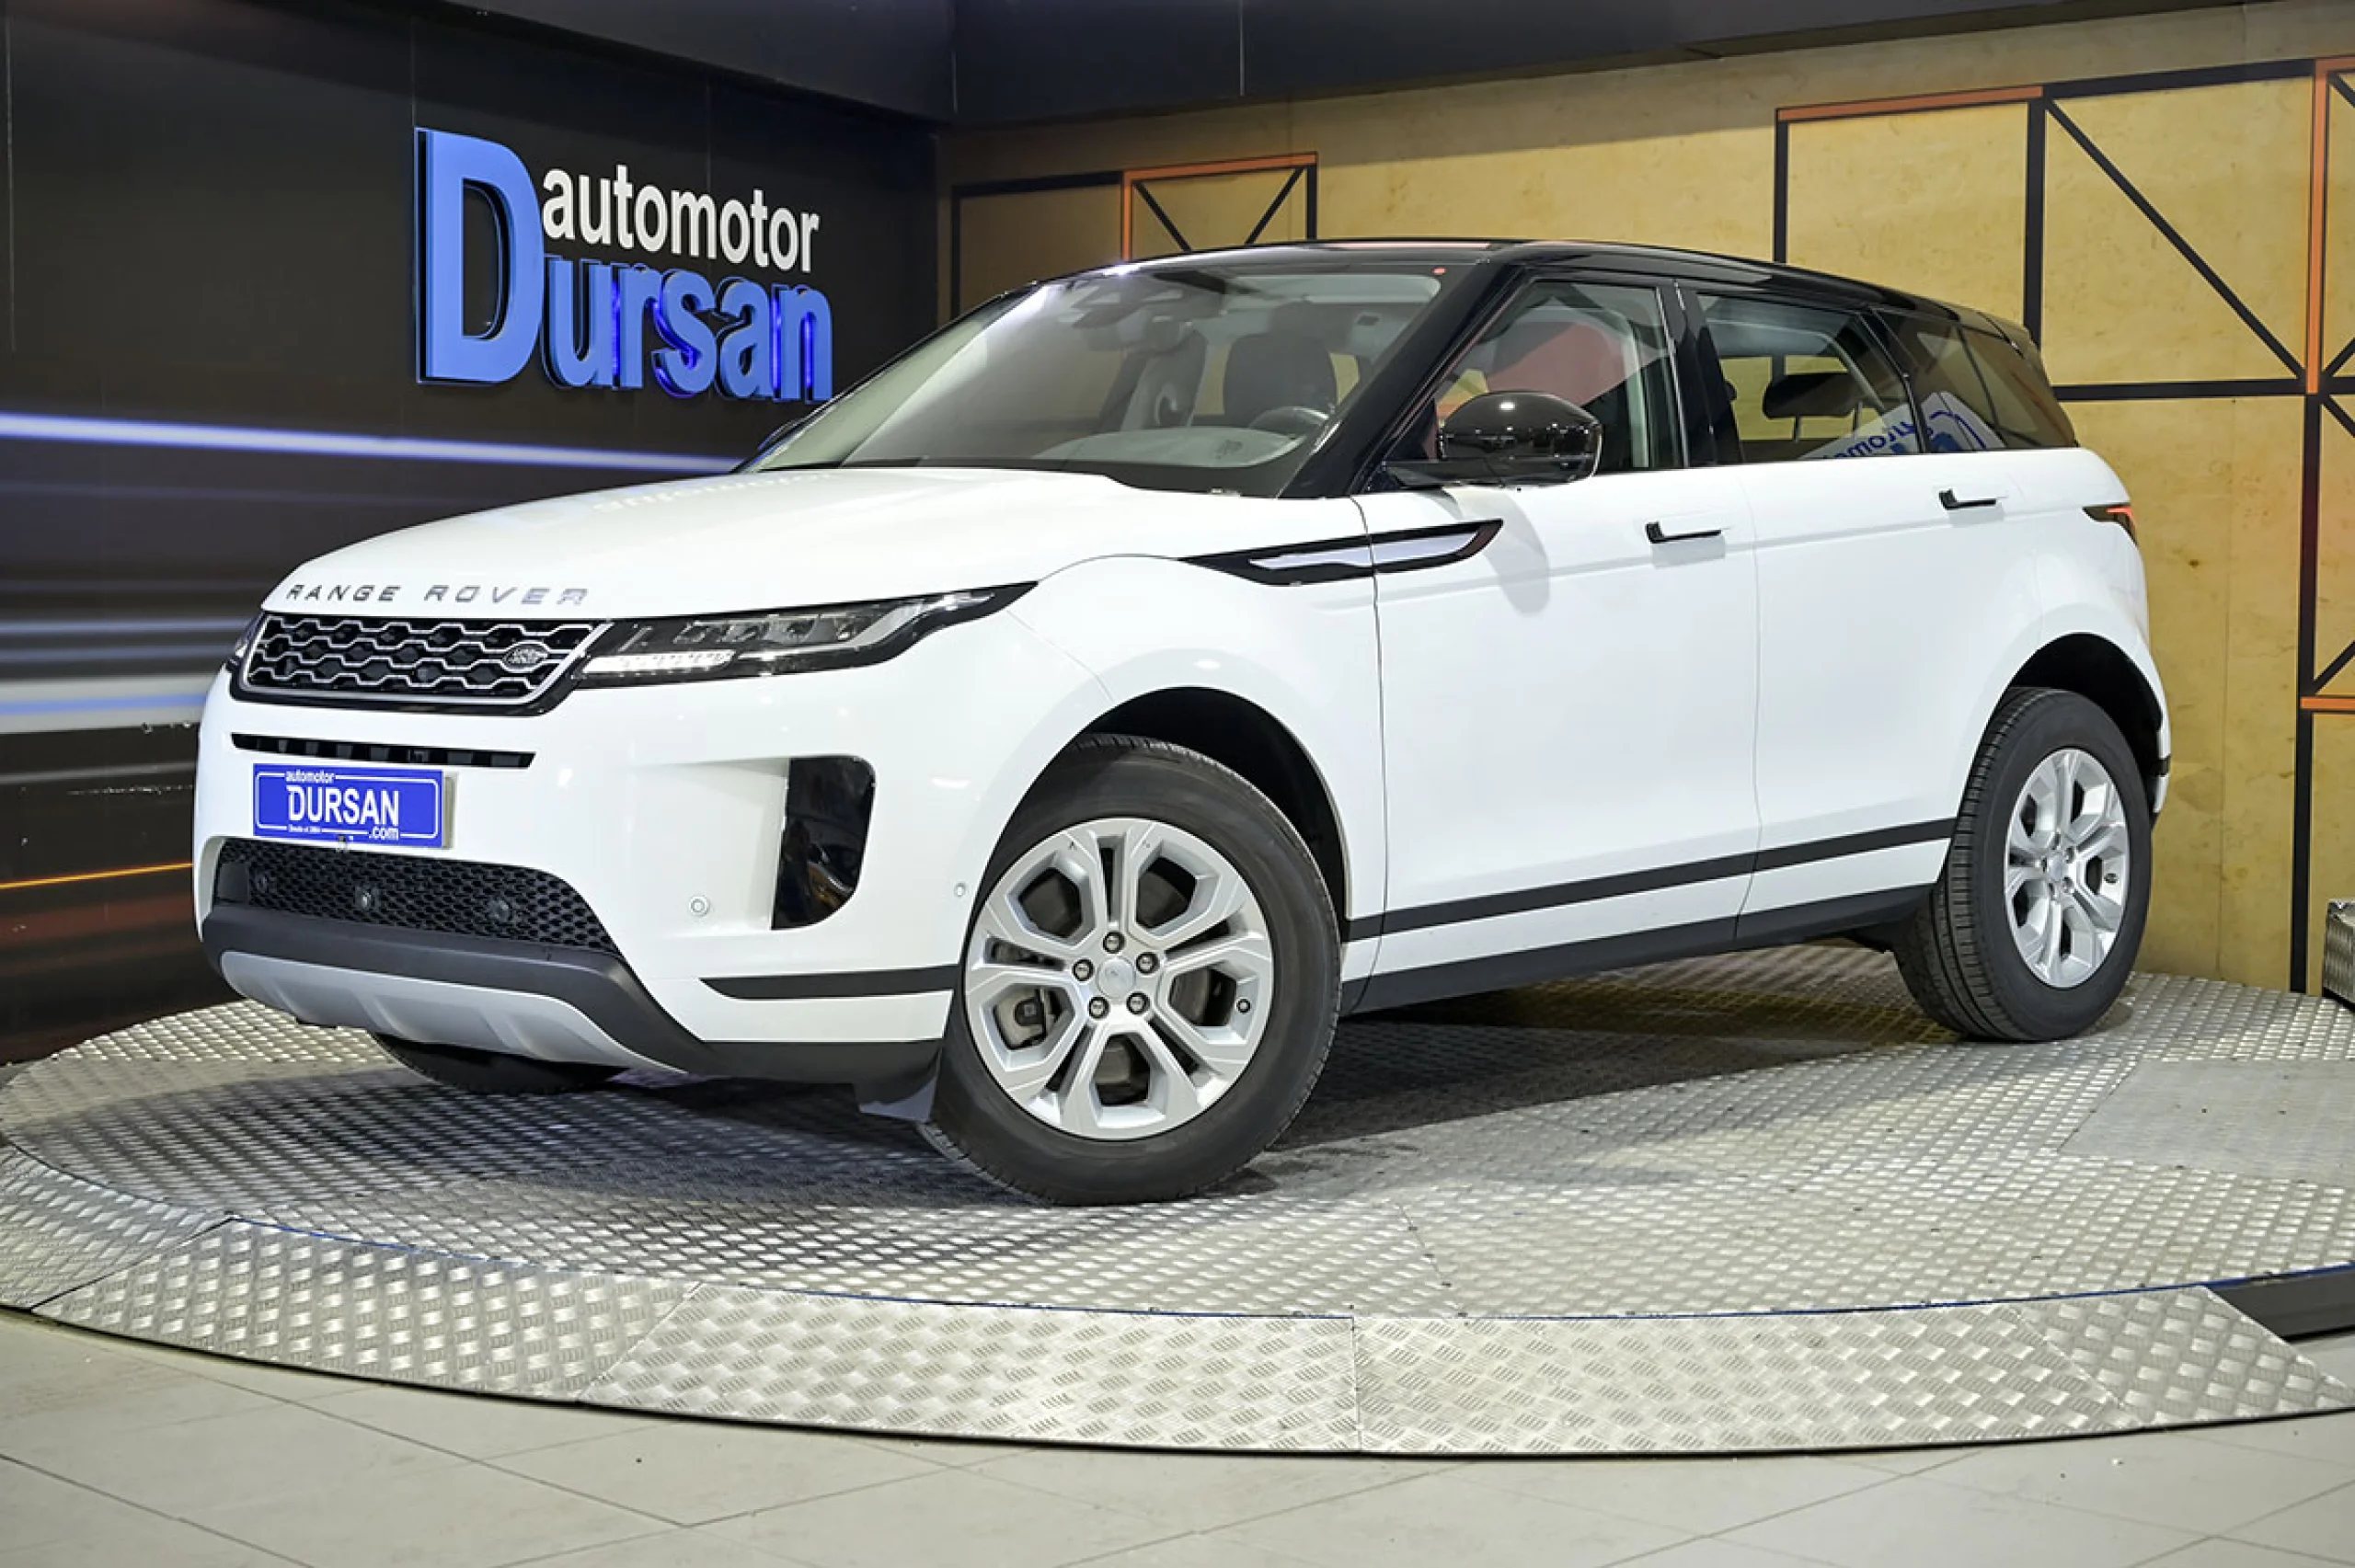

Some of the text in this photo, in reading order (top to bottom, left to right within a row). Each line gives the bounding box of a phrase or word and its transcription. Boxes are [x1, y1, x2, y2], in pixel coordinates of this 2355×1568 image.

[542, 164, 821, 272] automotor
[415, 127, 833, 403] Dursan
[285, 584, 589, 605] RANGE ROVER
[285, 769, 335, 784] automotor
[286, 784, 399, 827] DURSAN
[368, 826, 399, 841] .com
